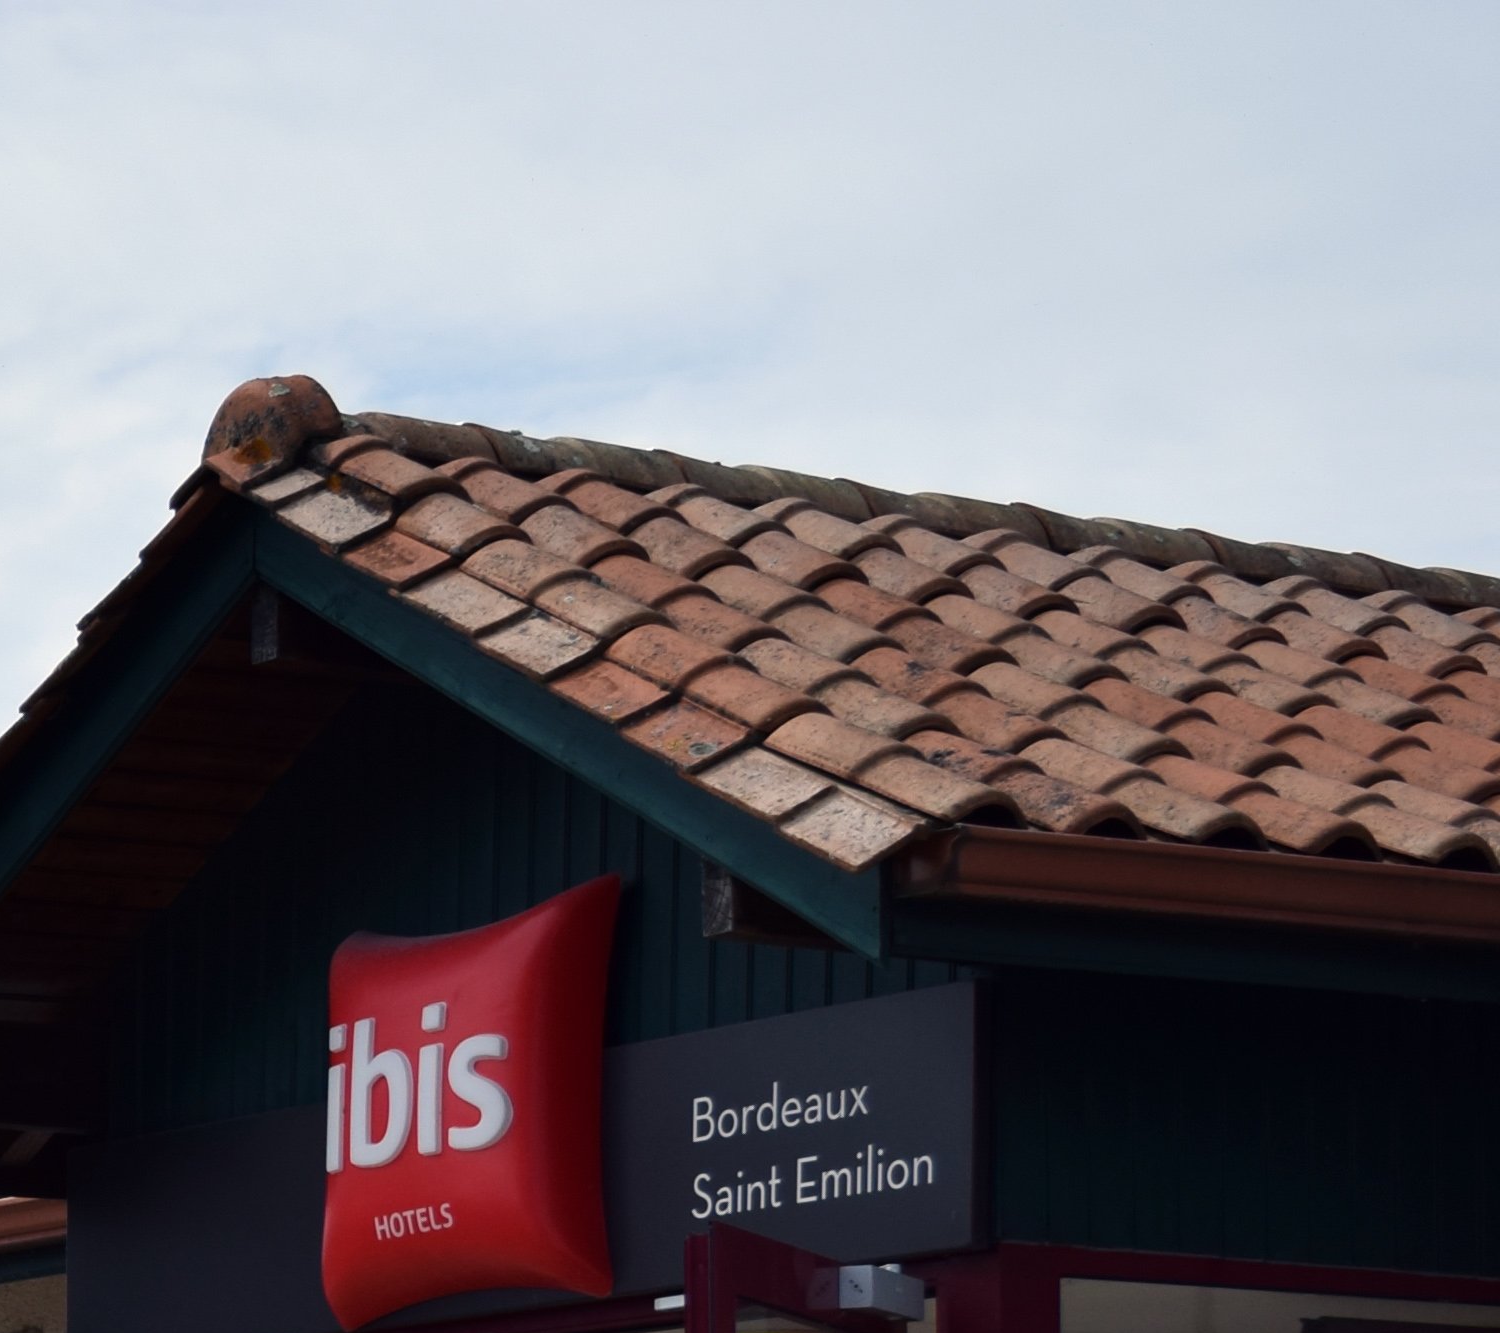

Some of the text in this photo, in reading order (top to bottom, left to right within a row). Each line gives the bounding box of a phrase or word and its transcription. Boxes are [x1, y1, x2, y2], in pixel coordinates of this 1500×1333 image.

[326, 1001, 513, 1174] ibis
[690, 1080, 870, 1143] Bordeaux
[690, 1143, 934, 1219] Saint Emilion
[373, 1202, 454, 1240] HOTELS
